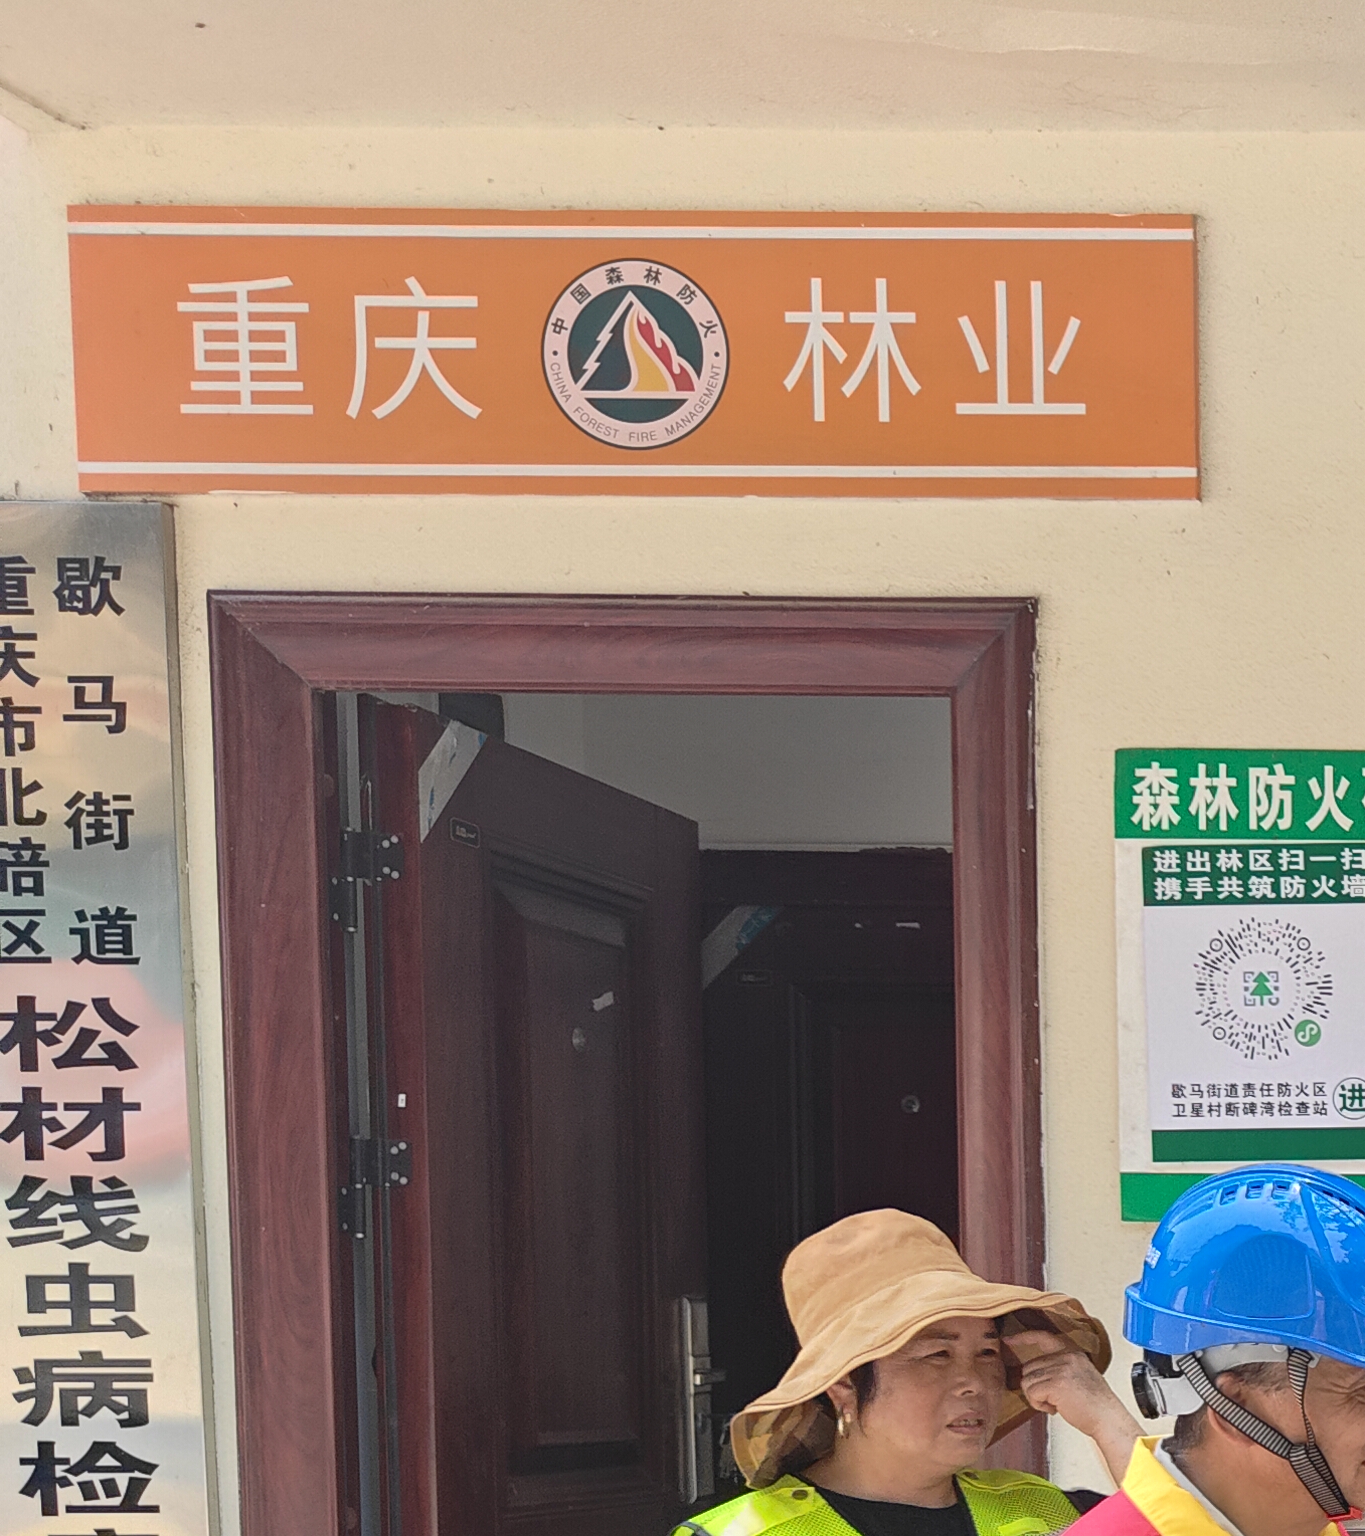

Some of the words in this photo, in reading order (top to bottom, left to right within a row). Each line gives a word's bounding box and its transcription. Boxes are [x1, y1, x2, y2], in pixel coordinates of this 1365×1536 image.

[550, 265, 719, 339] 中国森林防火
[177, 274, 483, 420] 重庆
[783, 276, 1087, 423] 林业
[550, 361, 573, 403] CHINA
[573, 405, 620, 439] FOREST
[628, 429, 658, 442] FIRE
[664, 363, 722, 437] MANAGEMENT
[53, 555, 141, 966] 歇马街道
[1171, 1081, 1328, 1099] 歇马街道责任防火区
[1171, 1100, 1328, 1118] 卫星村断碑湾检查站
